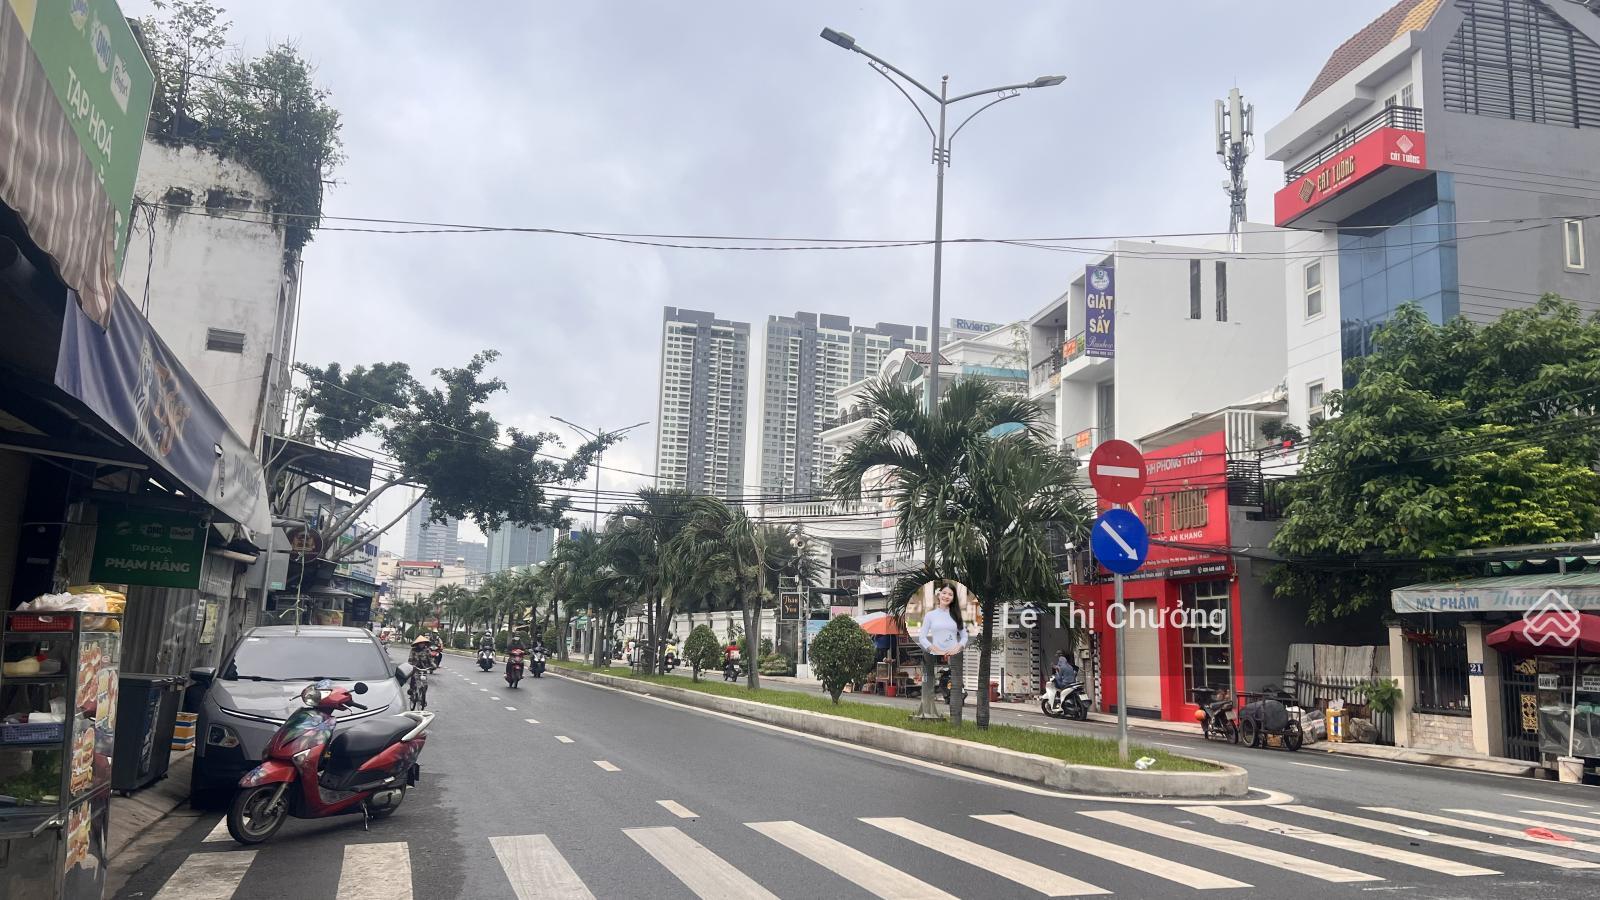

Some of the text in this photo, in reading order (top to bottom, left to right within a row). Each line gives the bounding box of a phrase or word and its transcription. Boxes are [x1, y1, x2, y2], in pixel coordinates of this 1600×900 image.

[66, 65, 114, 164] TẠP HOÁ
[1317, 167, 1331, 192] CÁT
[1087, 291, 1114, 314] GIẶT
[956, 318, 990, 333] Riviera
[1089, 314, 1111, 334] SẤY
[1179, 530, 1204, 541] KHANG
[104, 557, 148, 572] PHẠM
[1470, 663, 1482, 673] 21
